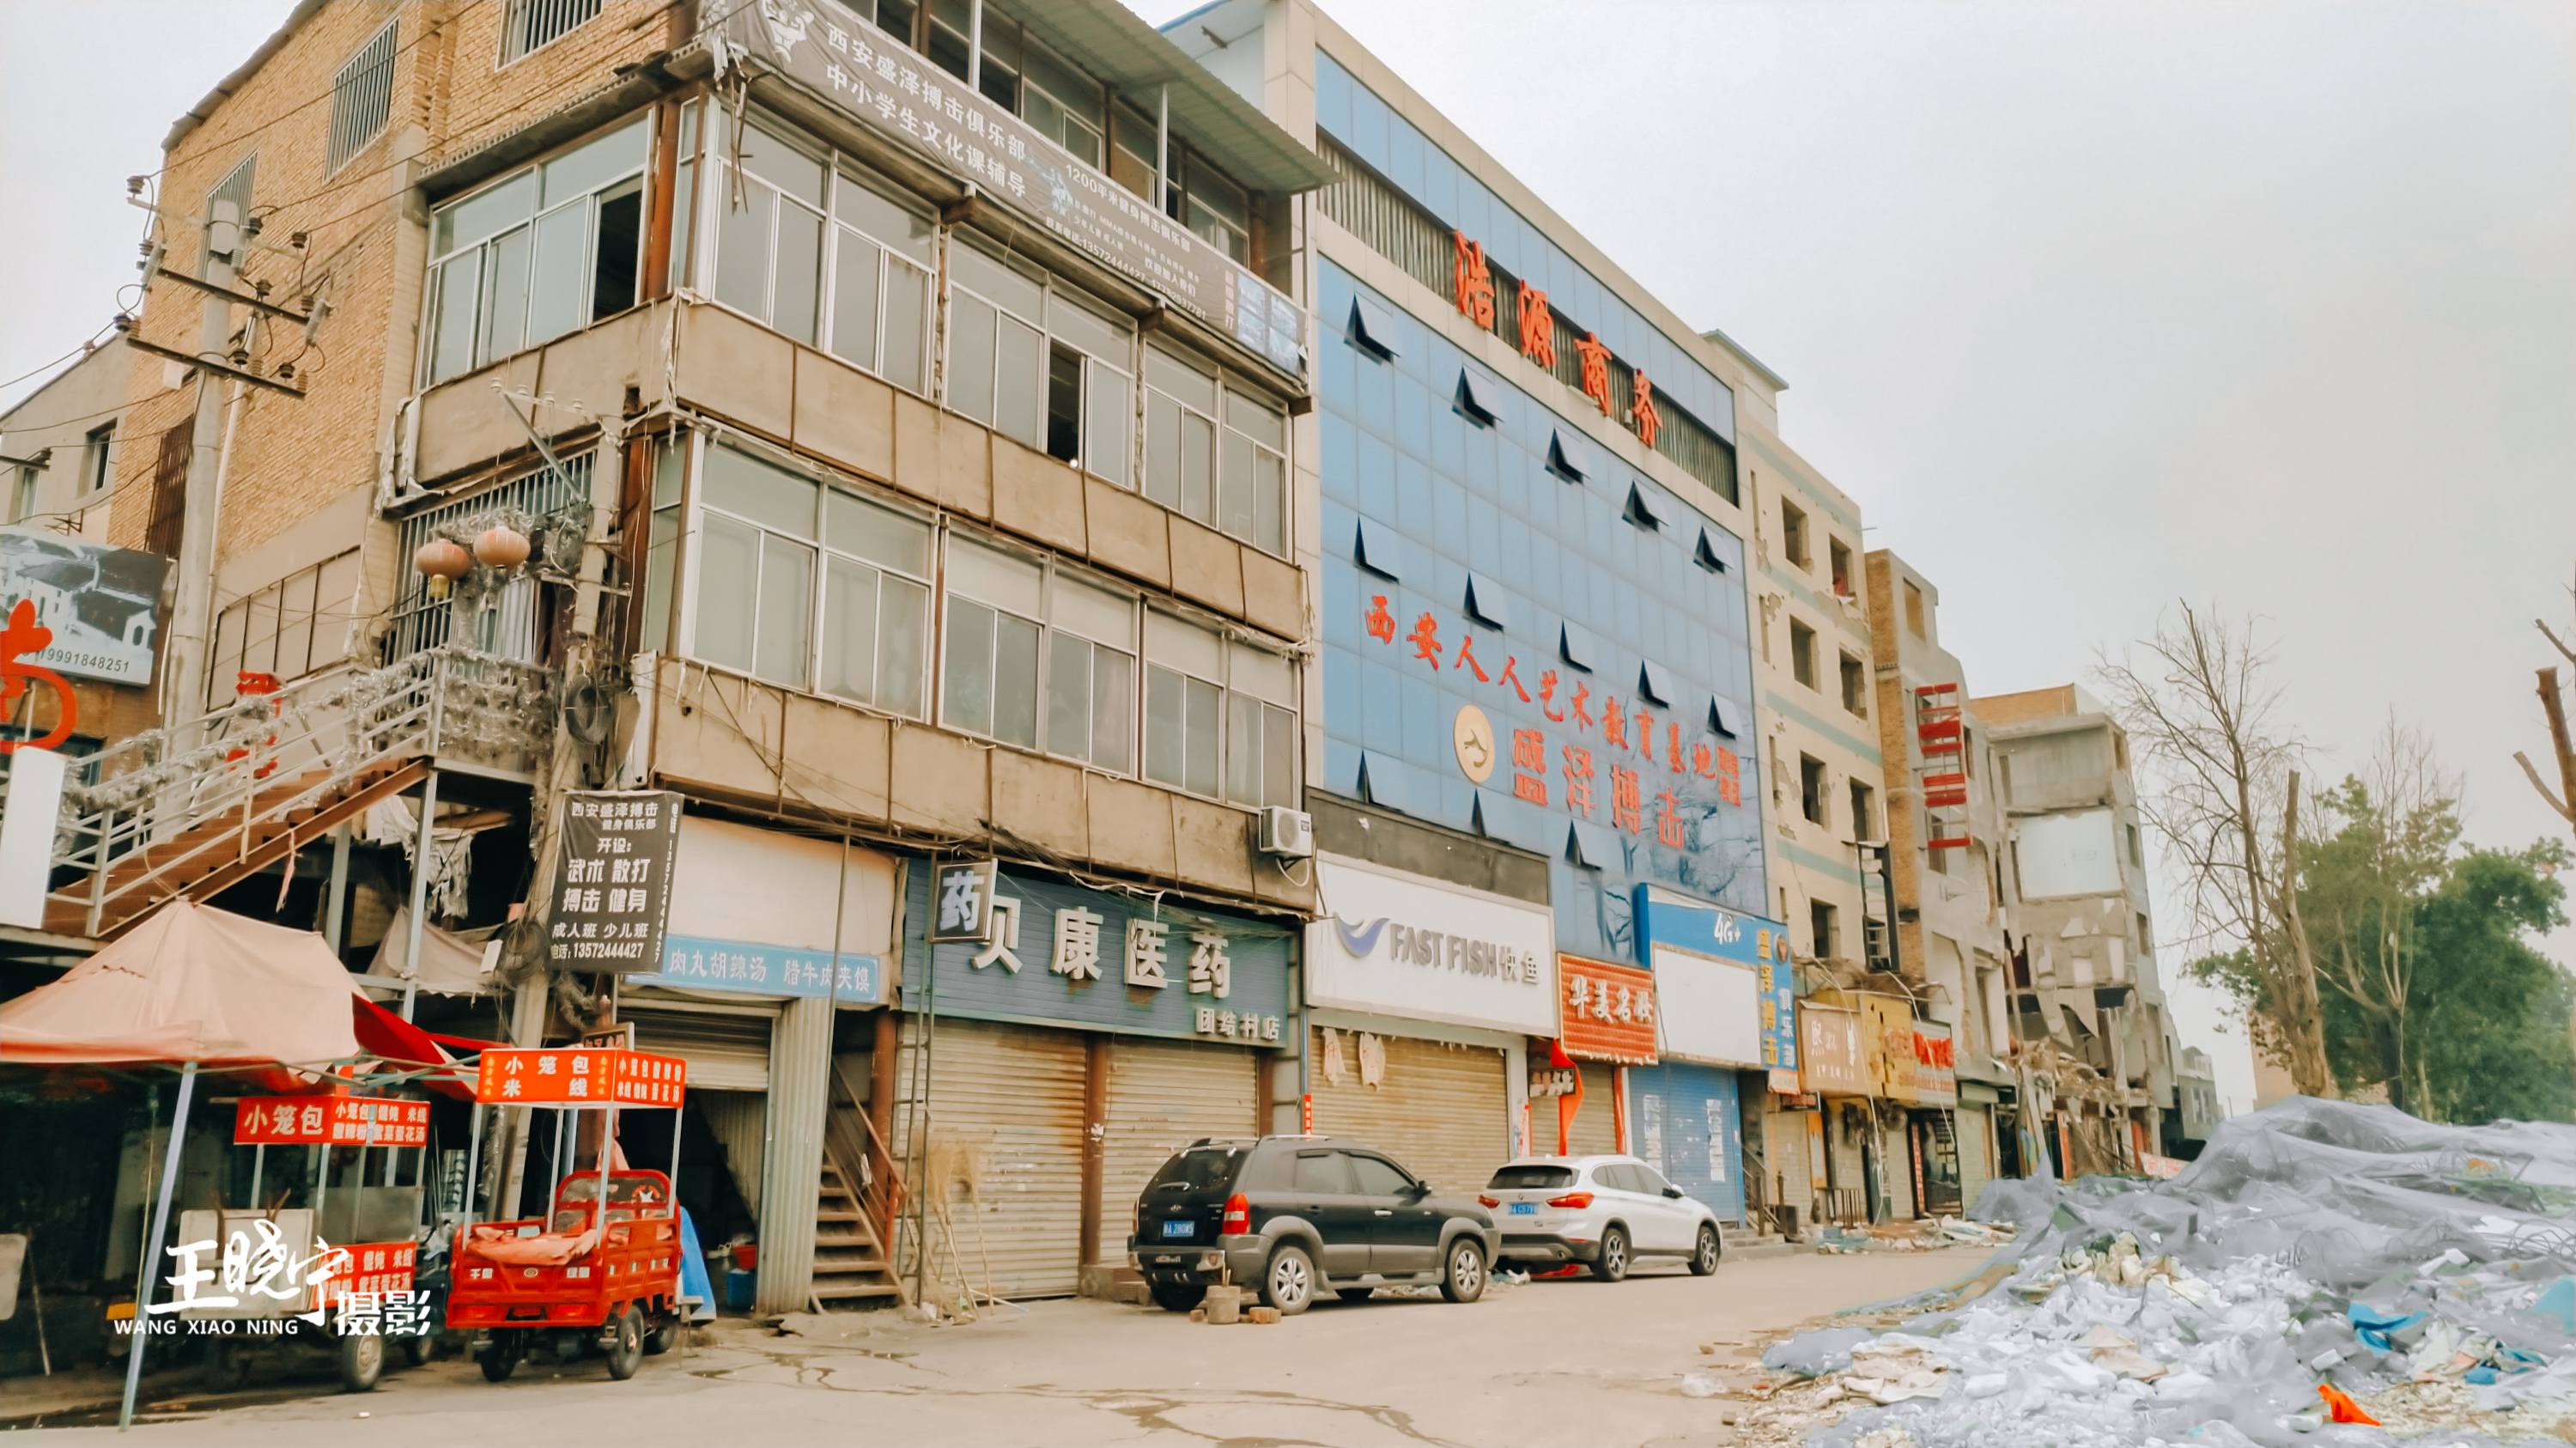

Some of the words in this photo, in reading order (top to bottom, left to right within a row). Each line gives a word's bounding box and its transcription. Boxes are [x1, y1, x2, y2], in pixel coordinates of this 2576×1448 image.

[827, 21, 1025, 161] 西安盛泽搏击俱乐部
[826, 64, 1026, 198] 中小学生文化课辅导
[1365, 595, 1716, 780] 西安人人艺术教育基地
[1514, 727, 1684, 849] 盛泽搏击
[571, 802, 659, 818] 西安盛泽搏击
[602, 818, 657, 830] 健身俱乐部
[597, 837, 632, 854] 开设:
[567, 859, 605, 884] 武术
[611, 858, 651, 884] 散打
[562, 887, 602, 913] 搏击
[608, 887, 647, 913] 健身
[939, 870, 985, 932] 药
[551, 922, 598, 940] 成人班
[603, 922, 649, 940] 少儿班
[969, 894, 1230, 999] 贝康医药
[668, 948, 767, 983] 肉丸胡辣汤
[783, 958, 871, 993] 腊牛肉夹馍
[1389, 923, 1444, 969] FAST
[1447, 935, 1498, 978] FISH
[1499, 946, 1540, 985] 快鱼
[1195, 1007, 1280, 1040] 团结村店
[505, 1055, 590, 1074] 小笼包
[244, 1104, 324, 1135] 小笼包
